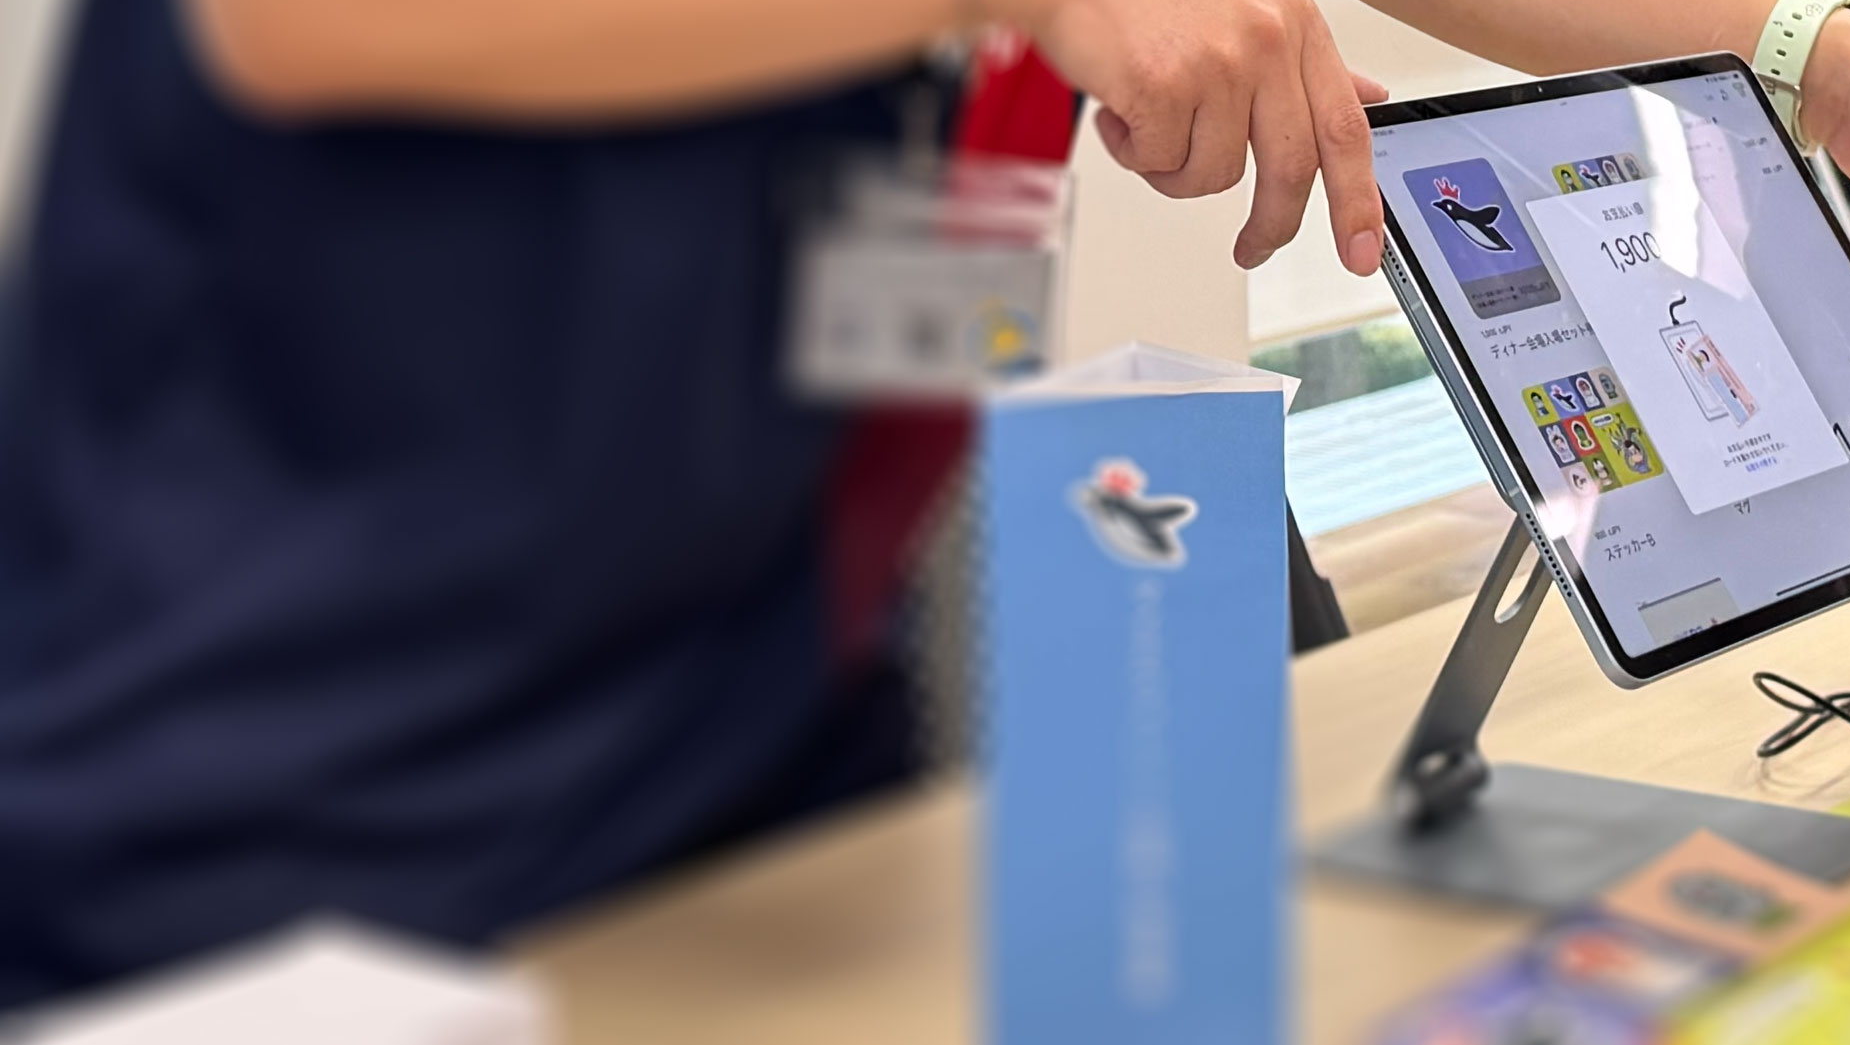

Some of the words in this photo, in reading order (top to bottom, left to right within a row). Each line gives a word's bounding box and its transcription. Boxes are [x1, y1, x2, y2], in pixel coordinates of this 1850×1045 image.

[1601, 232, 1661, 273] 1,900
[1604, 533, 1657, 561] ステッカーB
